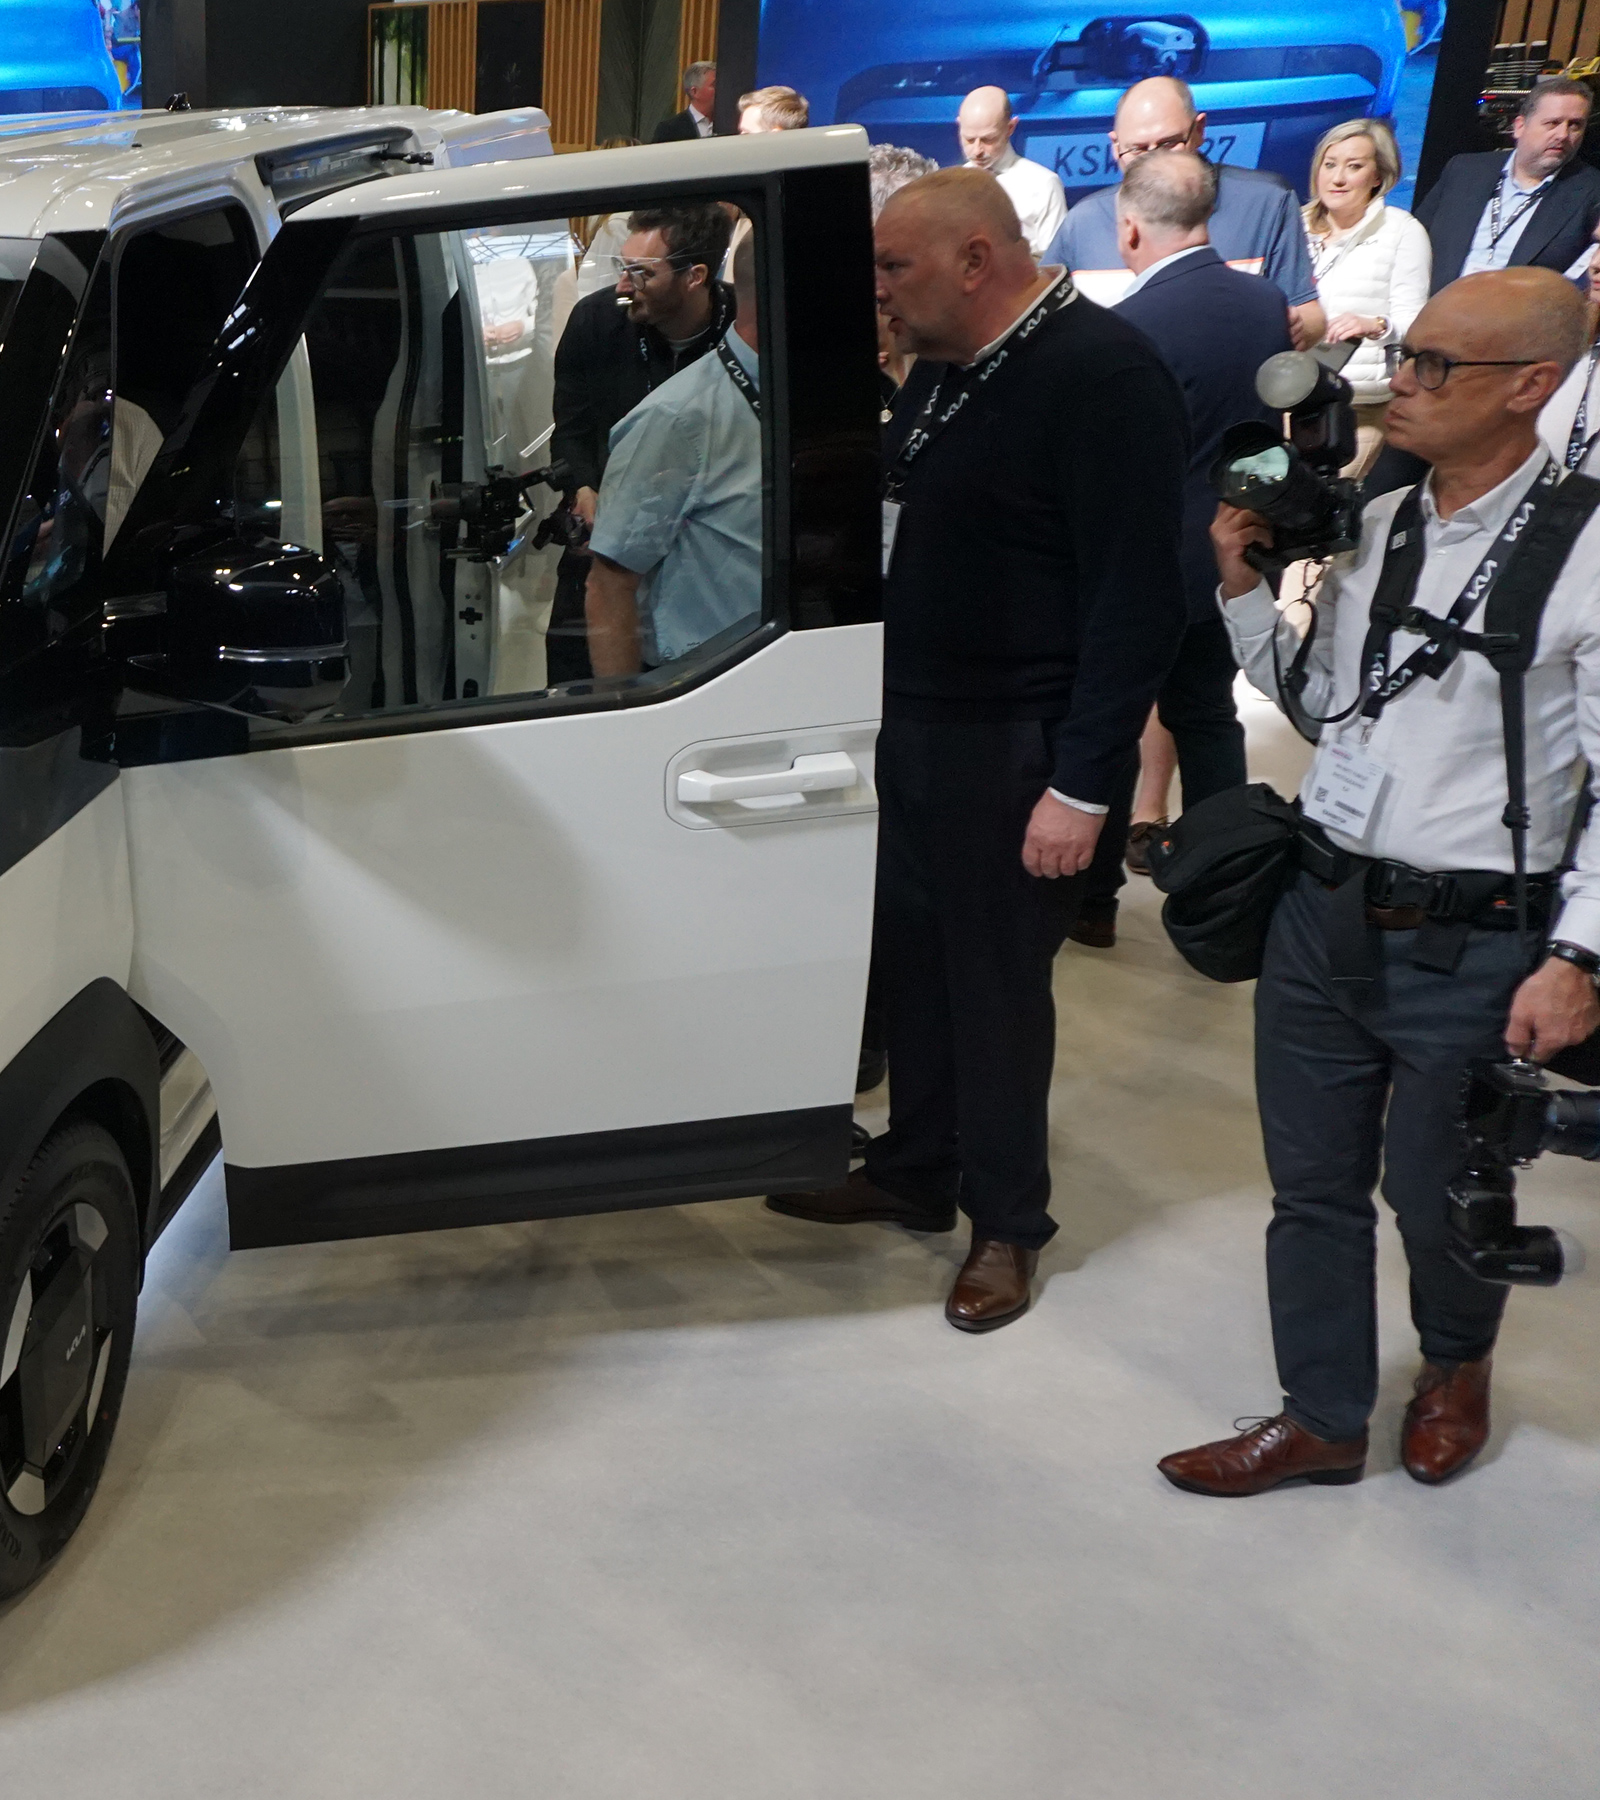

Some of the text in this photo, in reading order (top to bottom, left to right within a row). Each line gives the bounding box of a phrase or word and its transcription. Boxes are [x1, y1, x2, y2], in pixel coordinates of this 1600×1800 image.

[1018, 306, 1048, 339] KIA
[978, 349, 1009, 382] KIA
[940, 391, 970, 423] KIA
[1502, 501, 1536, 542] KIA
[1465, 559, 1499, 600] KIA
[65, 1324, 88, 1362] KIA
